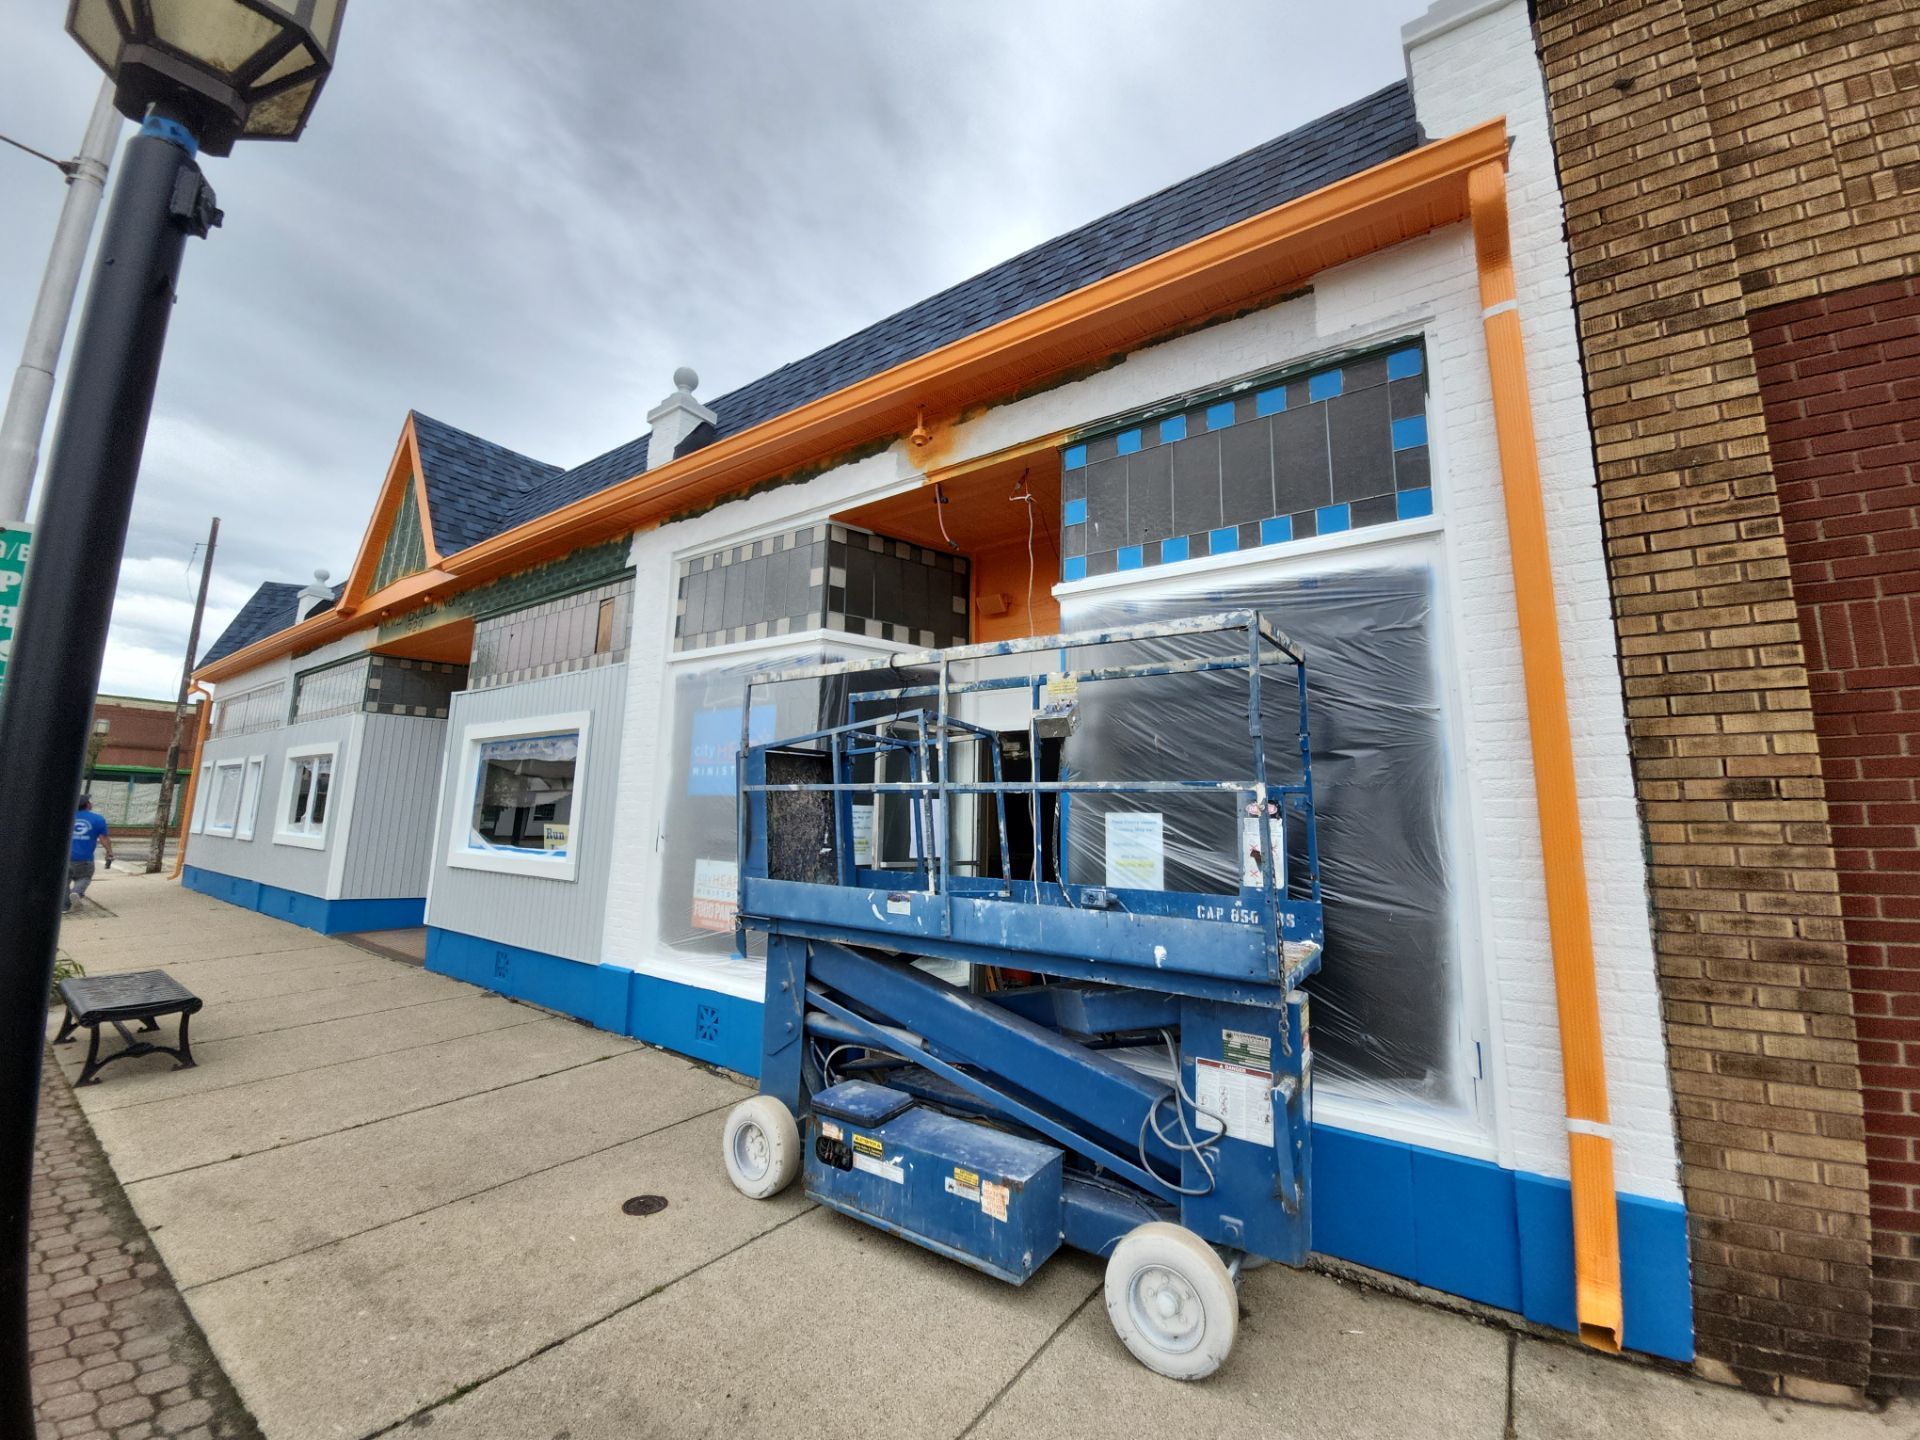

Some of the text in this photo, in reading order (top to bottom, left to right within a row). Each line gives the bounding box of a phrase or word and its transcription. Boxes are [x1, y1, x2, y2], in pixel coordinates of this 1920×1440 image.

[692, 765, 736, 777] MINIST
[546, 828, 564, 840] Run
[1197, 905, 1224, 921] CAP
